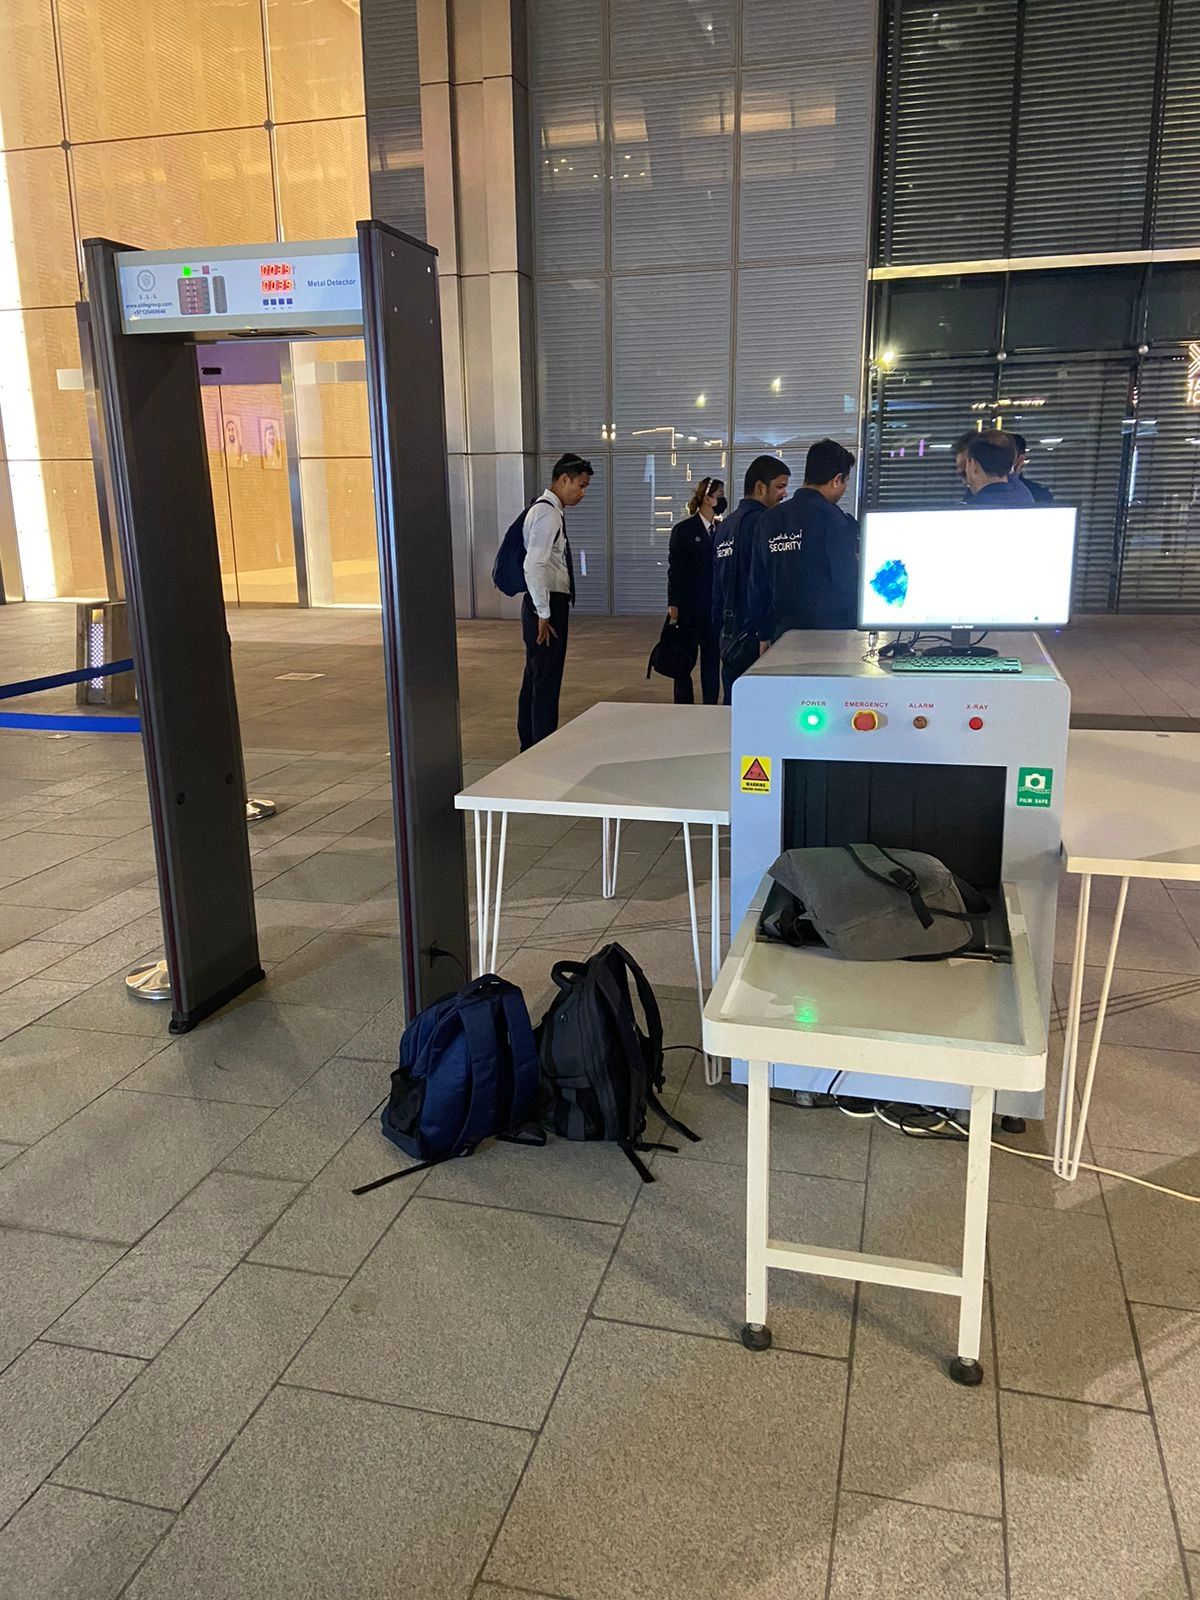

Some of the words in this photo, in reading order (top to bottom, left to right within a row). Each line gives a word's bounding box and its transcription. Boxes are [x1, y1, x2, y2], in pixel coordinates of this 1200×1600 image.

[307, 279, 326, 287] Metal
[327, 278, 356, 287] Detector
[769, 541, 802, 553] SECURITY
